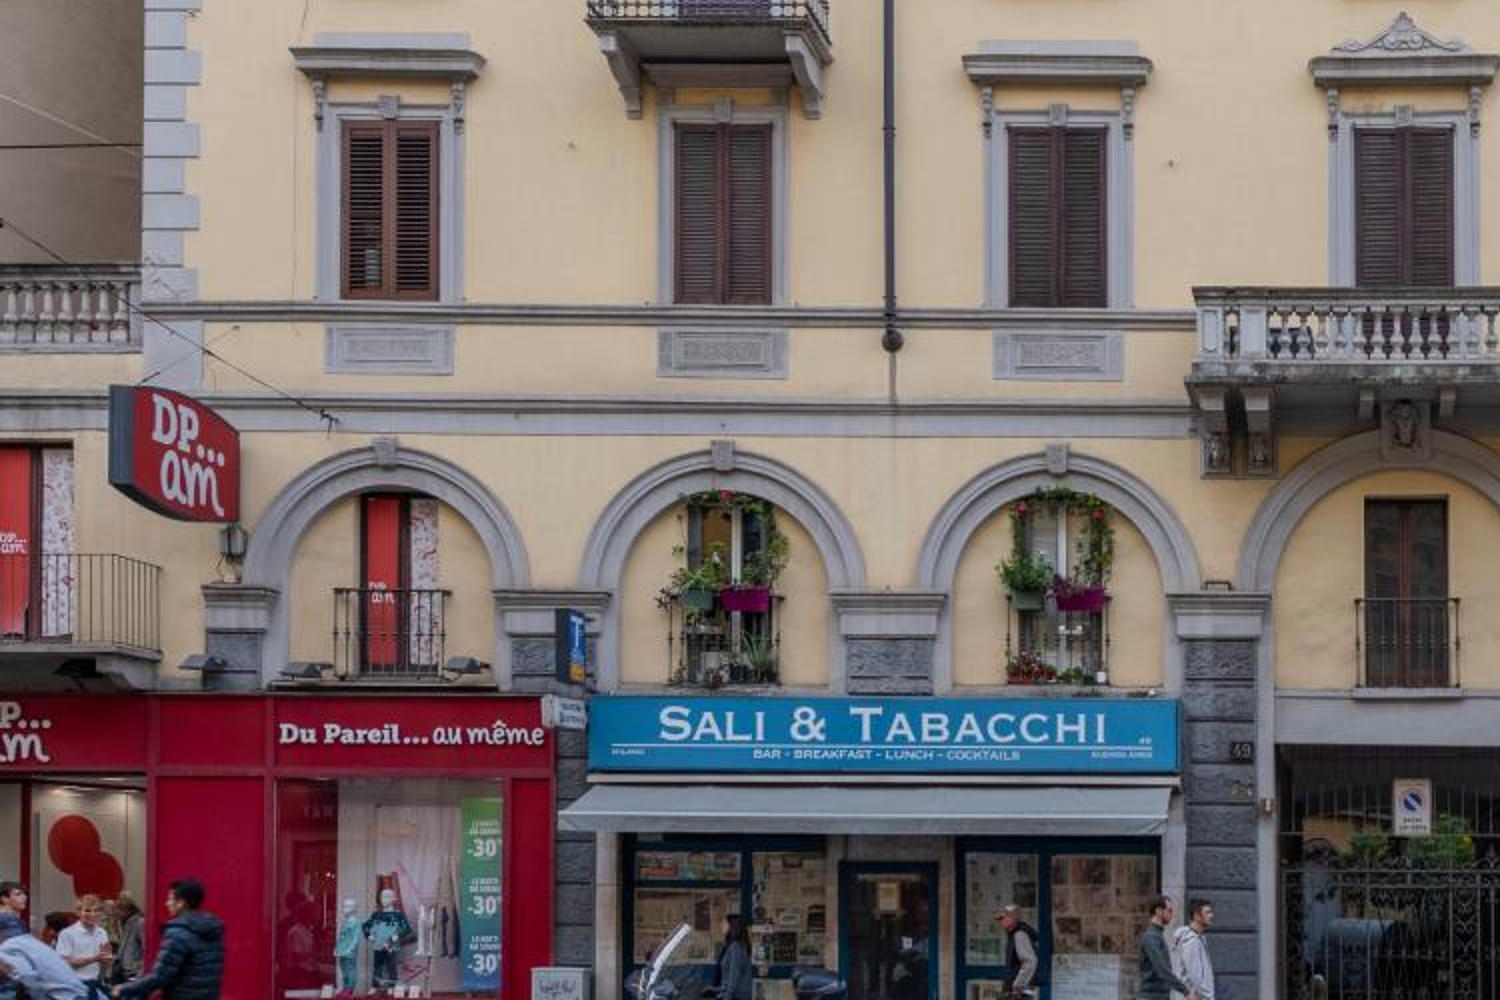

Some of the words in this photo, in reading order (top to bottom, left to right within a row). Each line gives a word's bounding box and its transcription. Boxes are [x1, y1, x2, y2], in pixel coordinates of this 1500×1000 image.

[161, 450, 225, 517] am
[0, 701, 52, 729] P...
[659, 705, 766, 742] SALI
[789, 706, 826, 742] &
[849, 706, 1106, 744] TABACCHI
[279, 723, 317, 744] Du
[432, 726, 461, 745] au
[466, 719, 545, 745] même
[0, 734, 50, 762] m
[752, 748, 781, 760] BAR
[793, 748, 873, 760] BREAKFAST
[884, 749, 934, 761] LUNCH
[946, 750, 1021, 762] COCKTAILS
